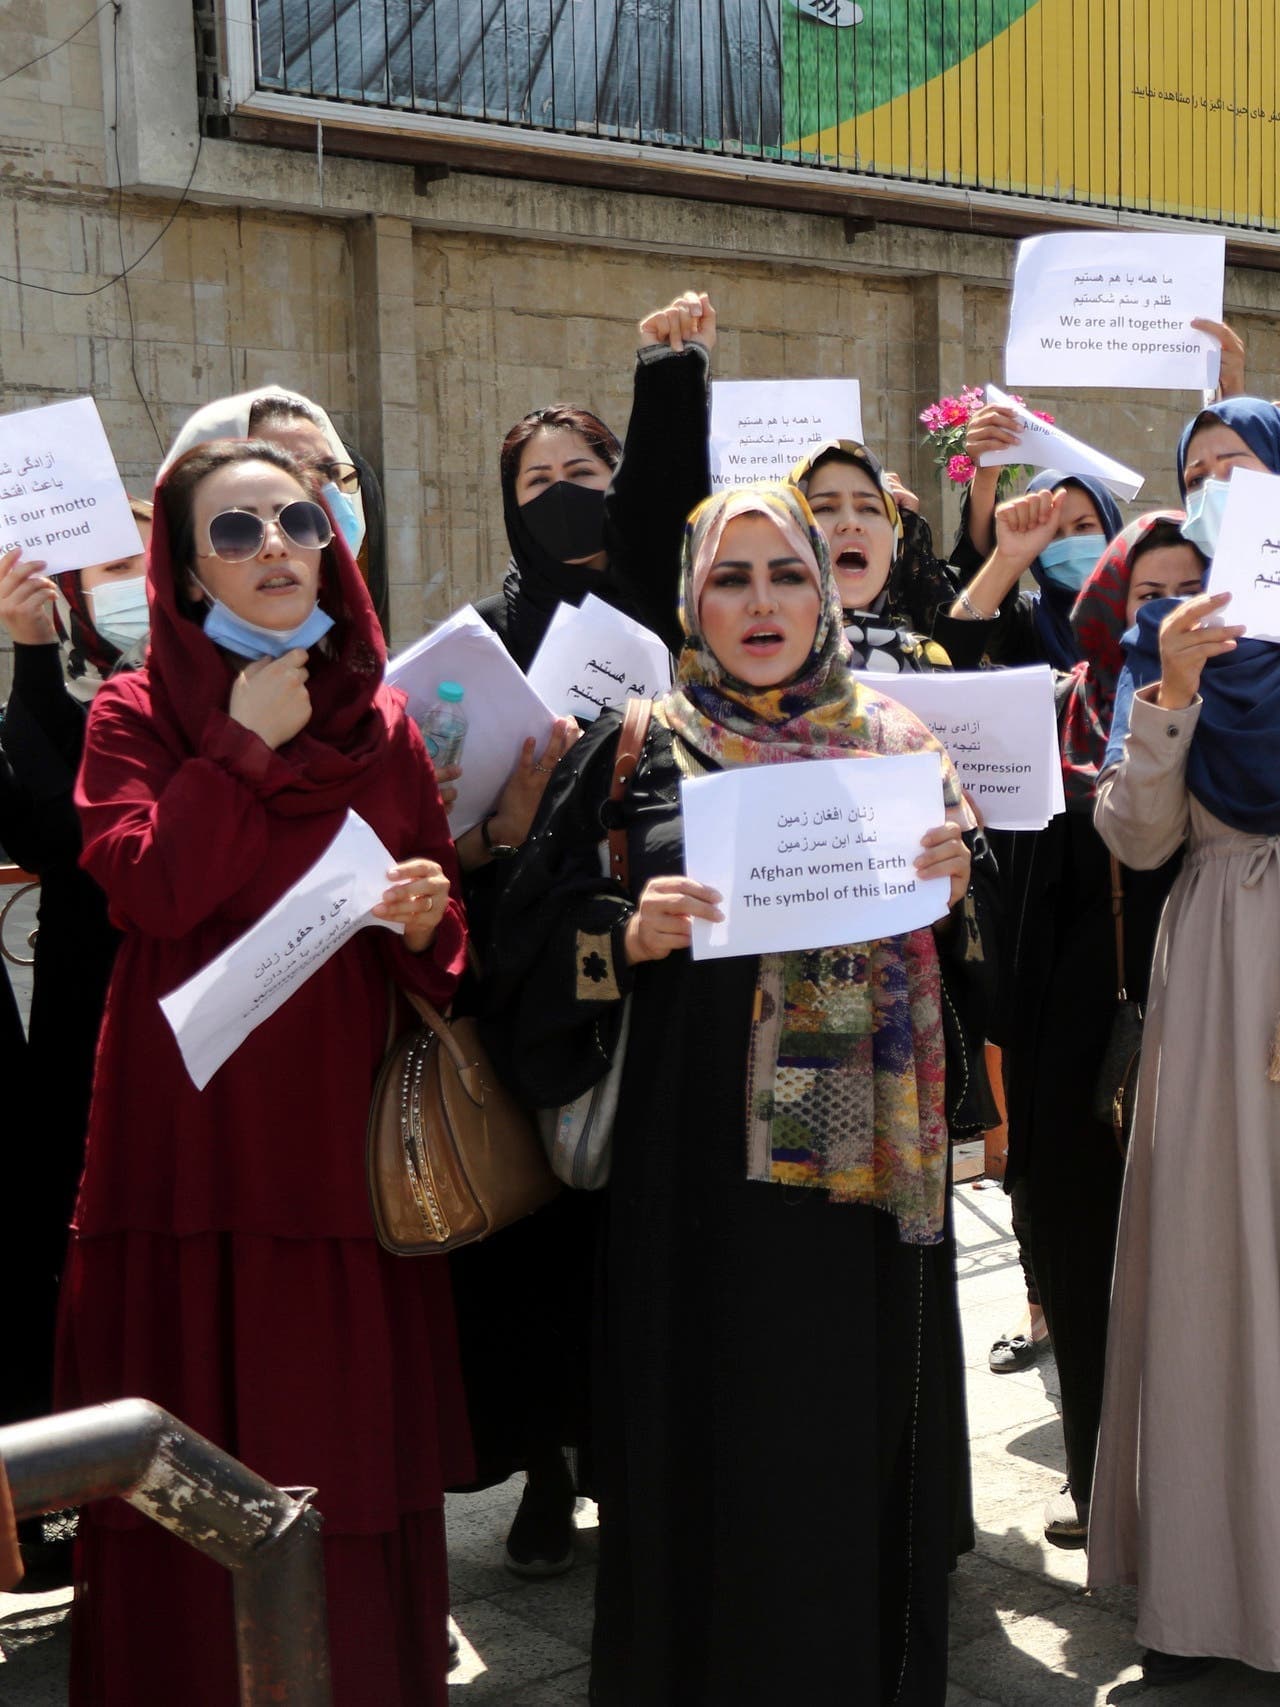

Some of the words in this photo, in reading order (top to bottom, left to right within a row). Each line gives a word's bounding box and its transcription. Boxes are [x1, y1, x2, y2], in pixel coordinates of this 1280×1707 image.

[1074, 274, 1104, 285] هستیم
[1109, 275, 1120, 286] هم
[1126, 273, 1134, 286] با
[1138, 274, 1157, 284] همه
[1162, 273, 1173, 284] ما
[1073, 295, 1115, 307] شکستیم
[1119, 297, 1138, 307] ستم
[1144, 297, 1150, 308] و
[1153, 295, 1172, 307] ظلم
[1060, 315, 1081, 327] We
[1085, 318, 1105, 327] are
[1110, 316, 1125, 328] all
[1128, 317, 1183, 332] together
[1041, 338, 1062, 349] We
[1066, 339, 1103, 350] broke
[1107, 339, 1128, 350] the
[1132, 342, 1201, 355] oppression
[729, 454, 746, 464] We
[750, 456, 768, 464] are
[772, 454, 784, 463] all
[712, 474, 730, 484] We
[4, 514, 17, 526] is
[21, 509, 45, 522] our
[51, 497, 96, 515] motto
[25, 536, 42, 547] us
[46, 521, 91, 545] proud
[584, 659, 625, 684] هستیم
[567, 685, 611, 706] کستیم
[626, 684, 645, 695] هم
[953, 742, 981, 752] نتیجه
[962, 761, 1032, 774] expression
[963, 781, 976, 791] ur
[979, 783, 1021, 794] power
[777, 810, 808, 827] زمین
[813, 807, 843, 825] افغان
[848, 806, 875, 822] زنان
[832, 834, 850, 849] این
[855, 831, 877, 844] نماد
[777, 837, 827, 853] سرزمین
[750, 865, 803, 882] Afghan
[808, 860, 863, 875] women
[868, 856, 906, 870] Earth
[744, 893, 771, 908] The
[776, 890, 830, 909] symbol
[833, 886, 849, 900] of
[853, 883, 880, 897] this
[884, 880, 916, 895] land
